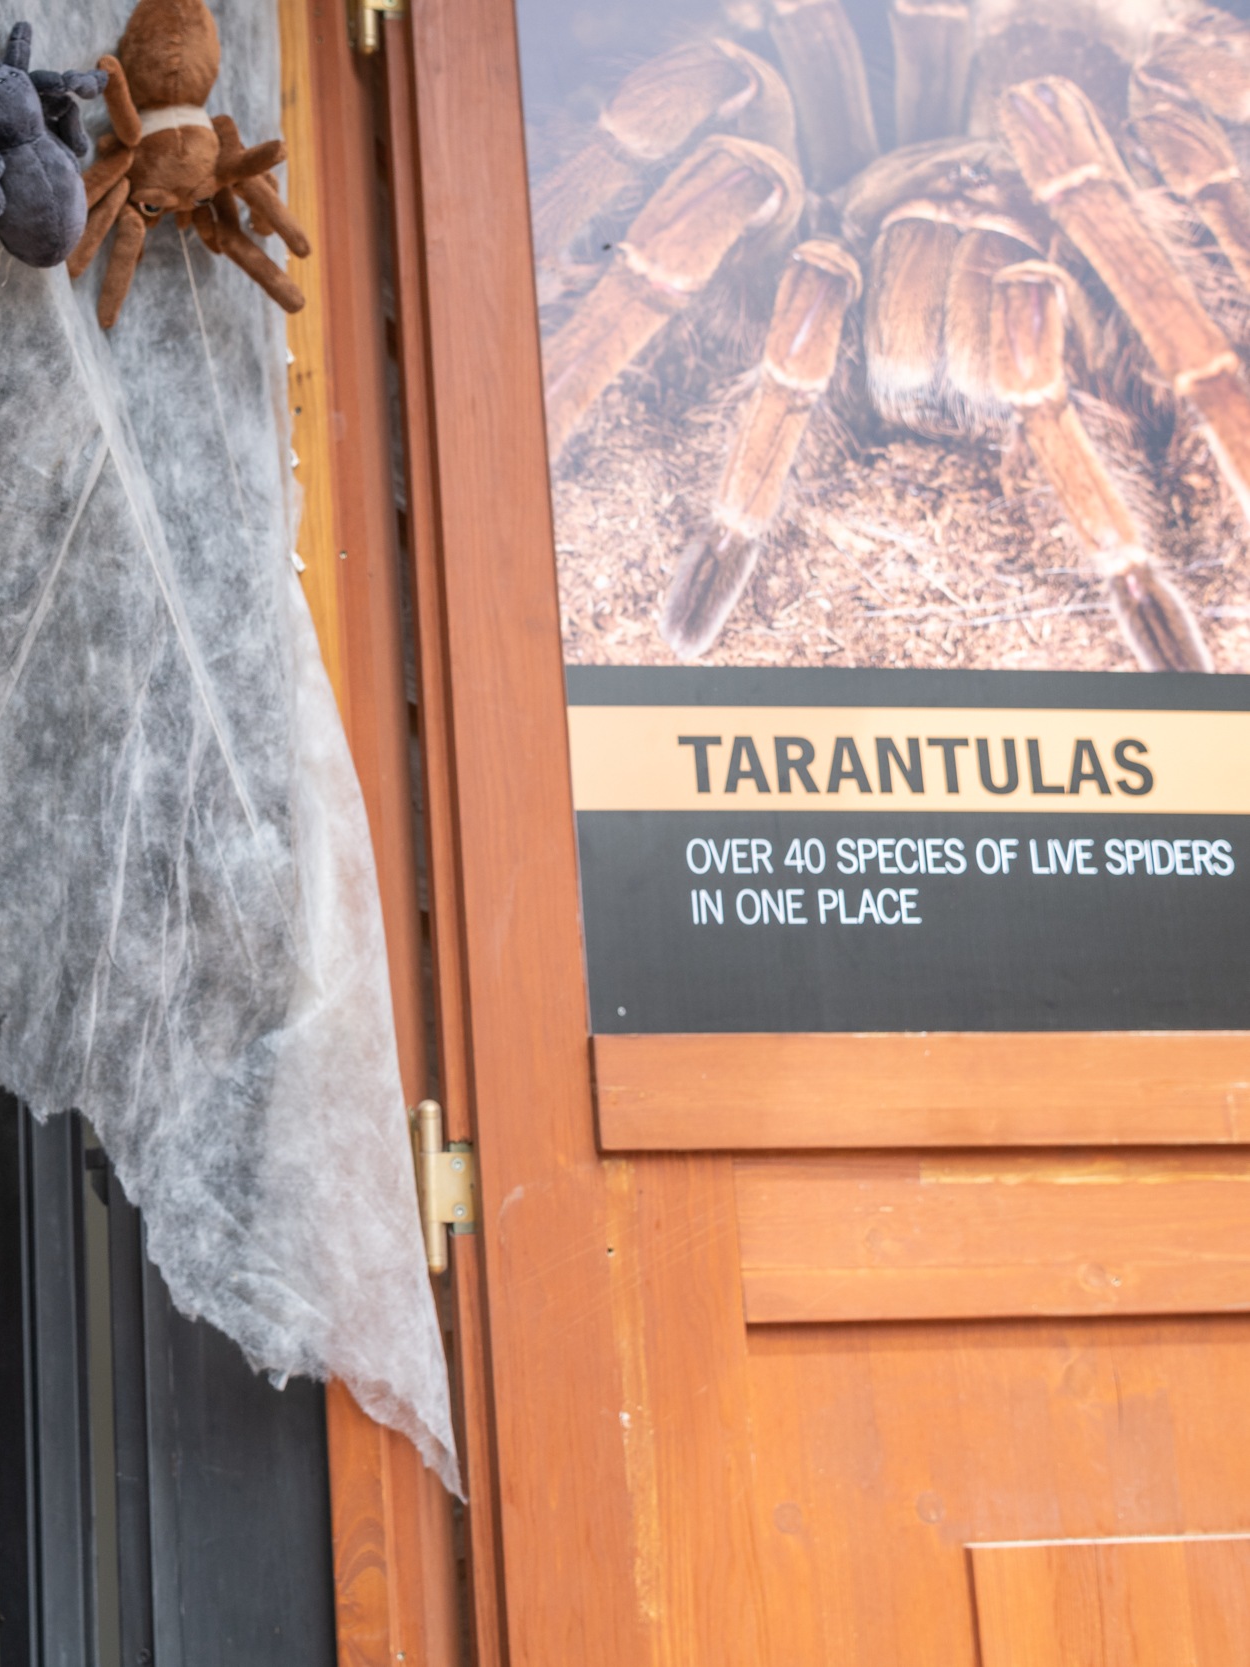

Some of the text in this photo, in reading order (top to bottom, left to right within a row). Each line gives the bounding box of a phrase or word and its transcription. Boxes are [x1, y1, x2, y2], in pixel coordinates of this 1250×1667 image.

[677, 735, 1155, 796] TARANTULAS
[685, 837, 1236, 878] OVER 40 SPECIES OF LIVE SPIDERS
[690, 887, 923, 926] IN ONE PLACE
